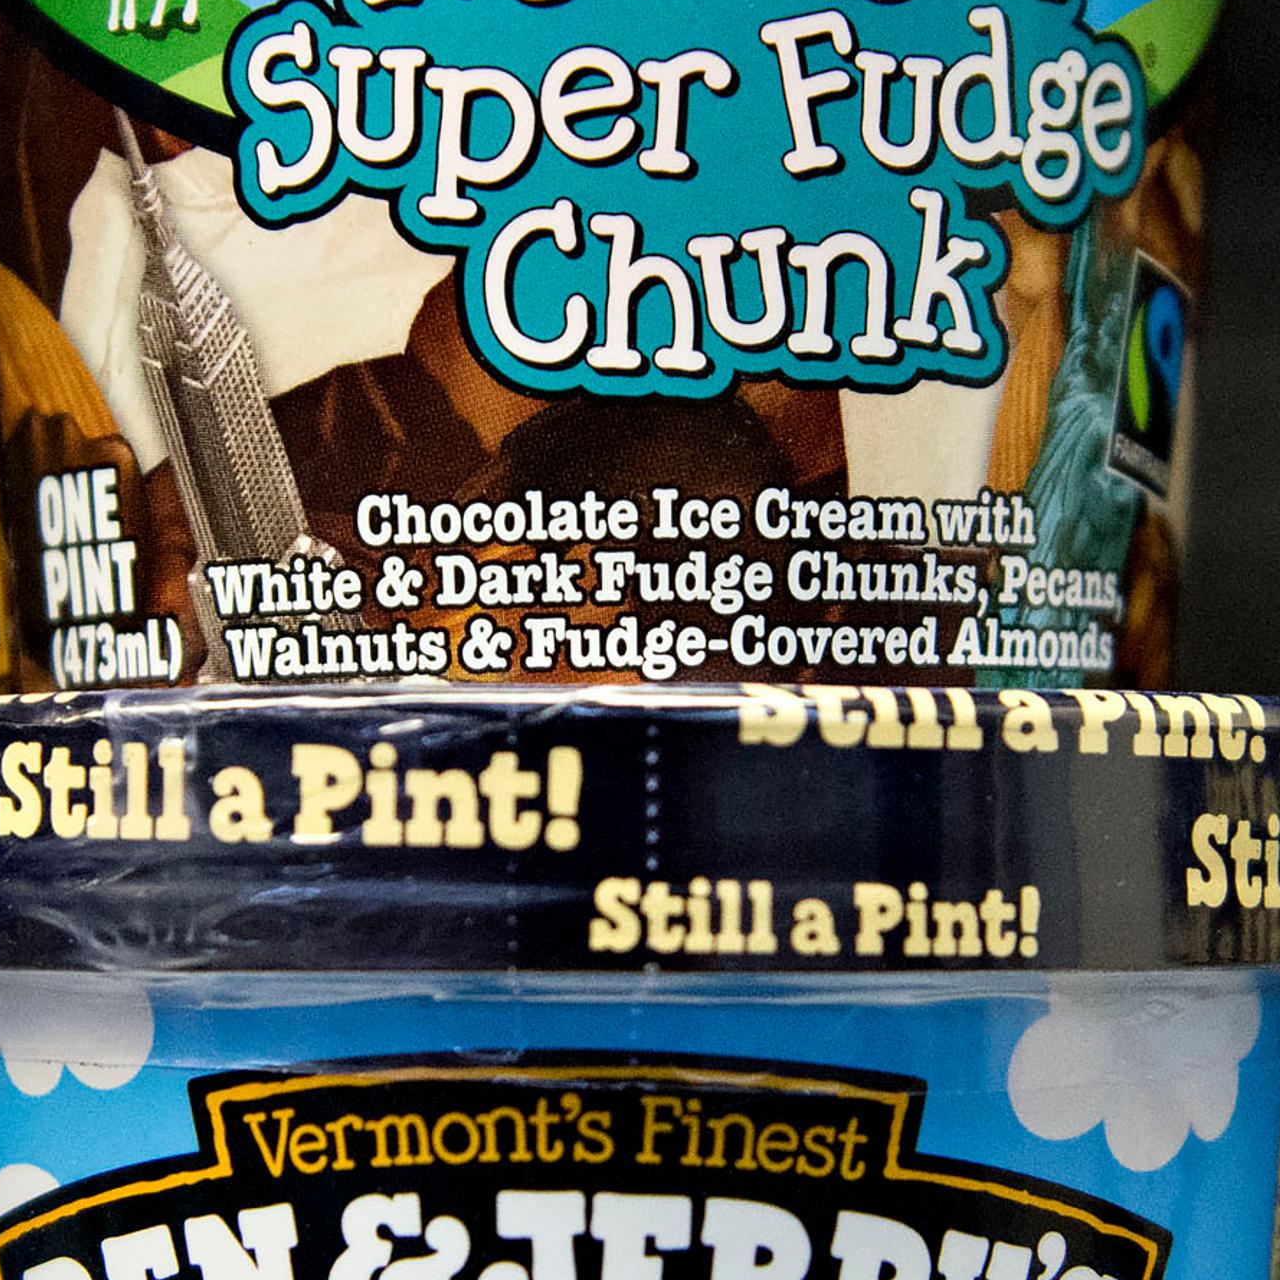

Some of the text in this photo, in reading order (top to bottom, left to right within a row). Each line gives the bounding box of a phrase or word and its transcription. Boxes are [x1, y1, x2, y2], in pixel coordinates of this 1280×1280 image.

[246, 6, 1135, 221] Super Fudge
[482, 188, 985, 373] Chunk
[37, 467, 121, 548] ONE
[356, 488, 1036, 548] Chocolate Ice Cream with
[43, 540, 137, 619] PINT
[206, 550, 1124, 618] White & Dark Fudge Chunks, Pecans,
[51, 619, 183, 690] (473mL)
[224, 616, 1115, 680] Walnuts & Fudge-Covered Almonds
[1001, 689, 1059, 754] a
[1076, 691, 1268, 765] Pint!
[208, 764, 274, 845] a
[289, 741, 583, 853] Pint!
[587, 876, 1041, 959] Still a Pint!
[242, 1092, 869, 1181] Vermont's Finest
